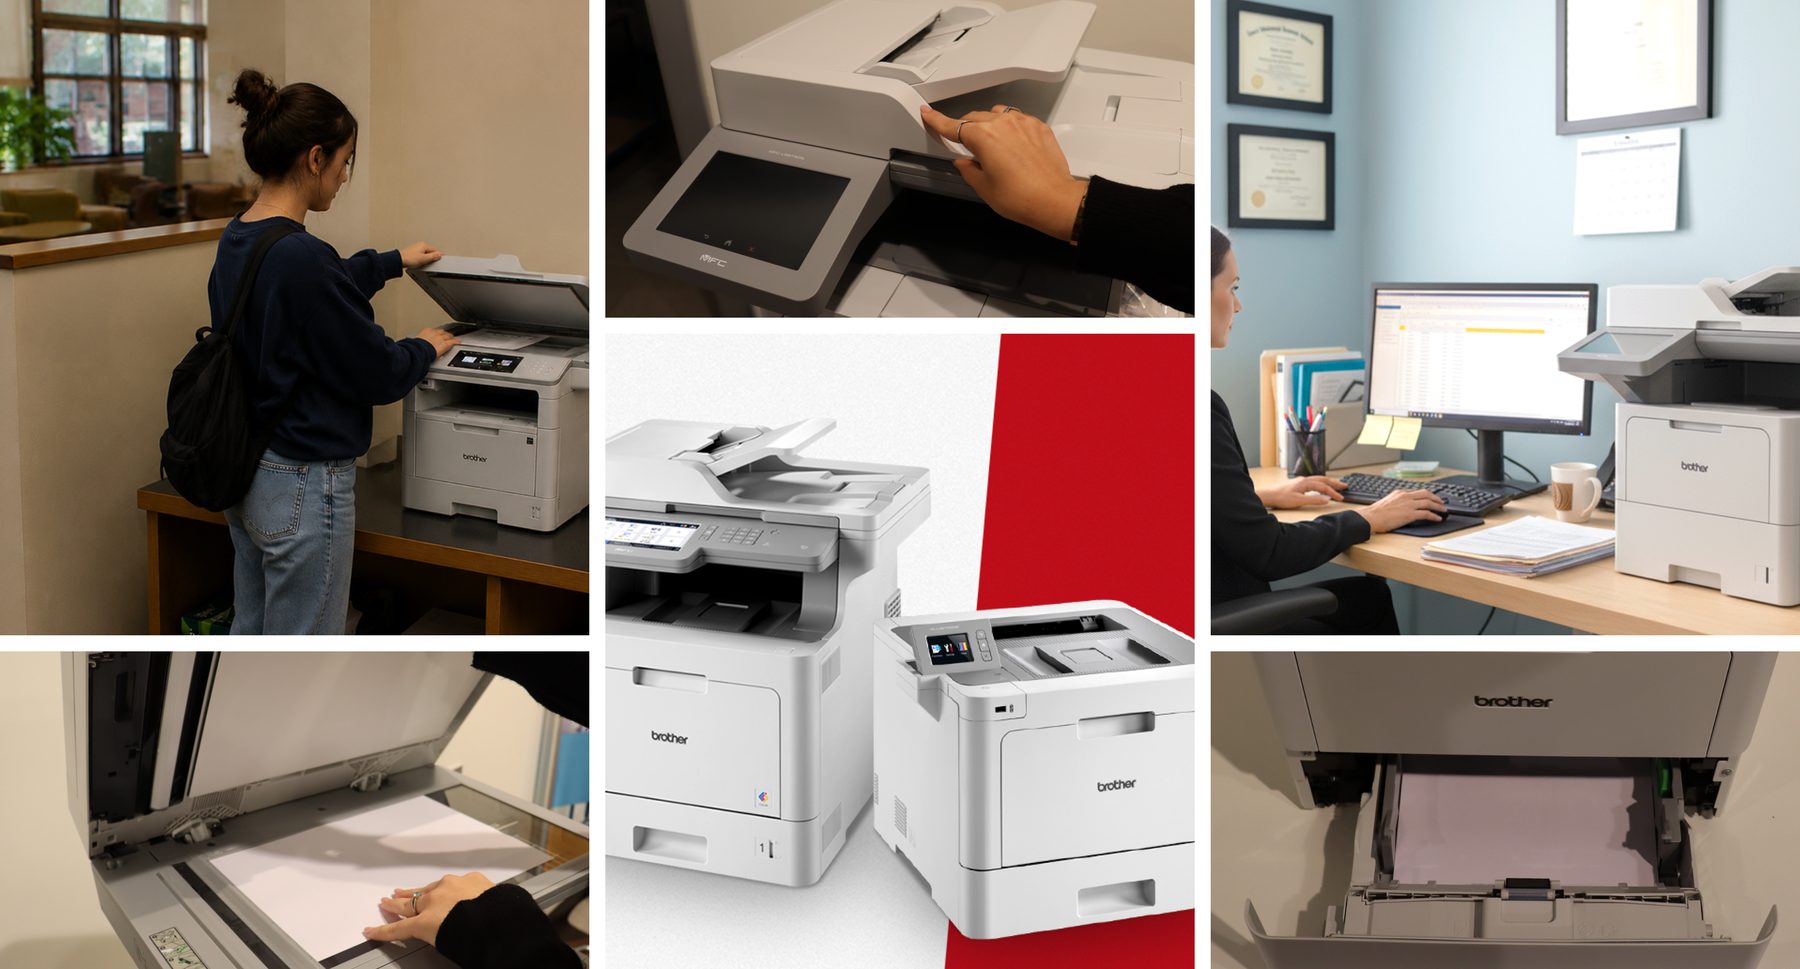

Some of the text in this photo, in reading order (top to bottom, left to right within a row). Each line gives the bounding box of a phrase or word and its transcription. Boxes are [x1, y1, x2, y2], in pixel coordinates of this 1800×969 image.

[699, 254, 728, 268] MFC
[462, 453, 487, 463] brother
[1681, 461, 1709, 472] brother
[1474, 696, 1554, 707] brother
[651, 730, 688, 744] brother
[1097, 779, 1137, 792] brother
